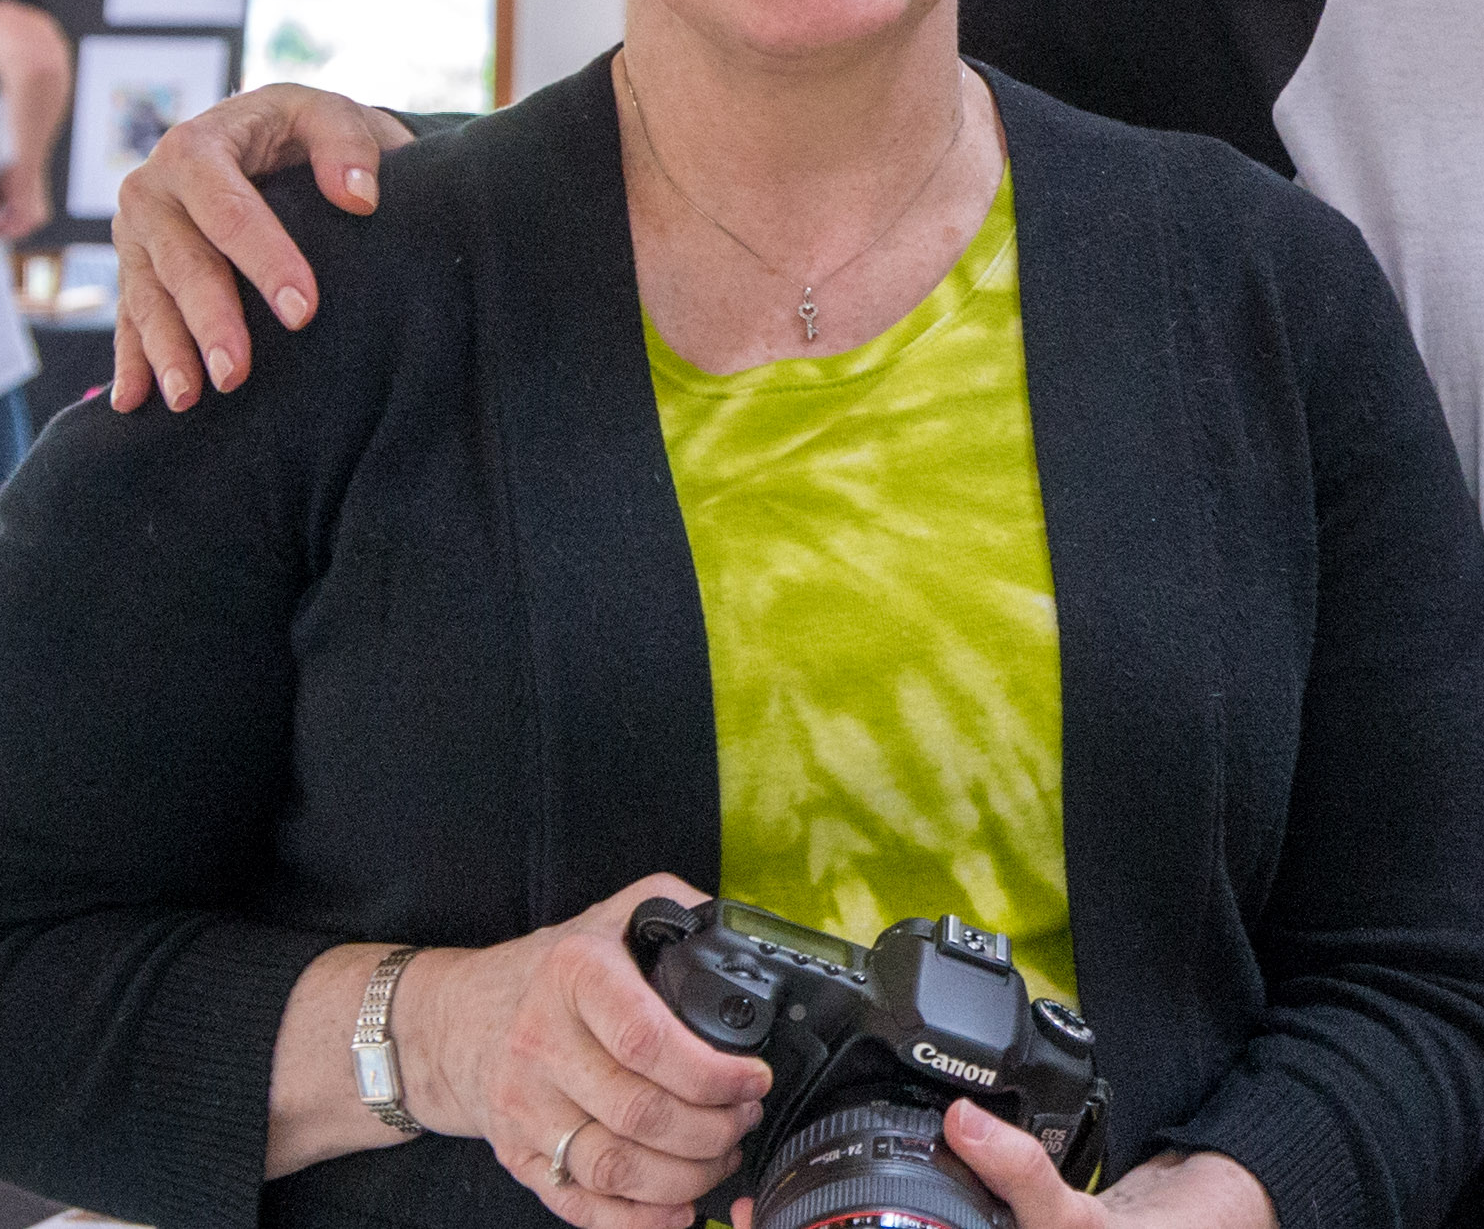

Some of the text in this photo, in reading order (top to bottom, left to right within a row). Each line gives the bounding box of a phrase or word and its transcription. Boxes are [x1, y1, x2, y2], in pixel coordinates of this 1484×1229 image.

[912, 1042, 997, 1087] Canon
[1041, 1128, 1067, 1141] EOS
[1042, 1140, 1063, 1154] 0D
